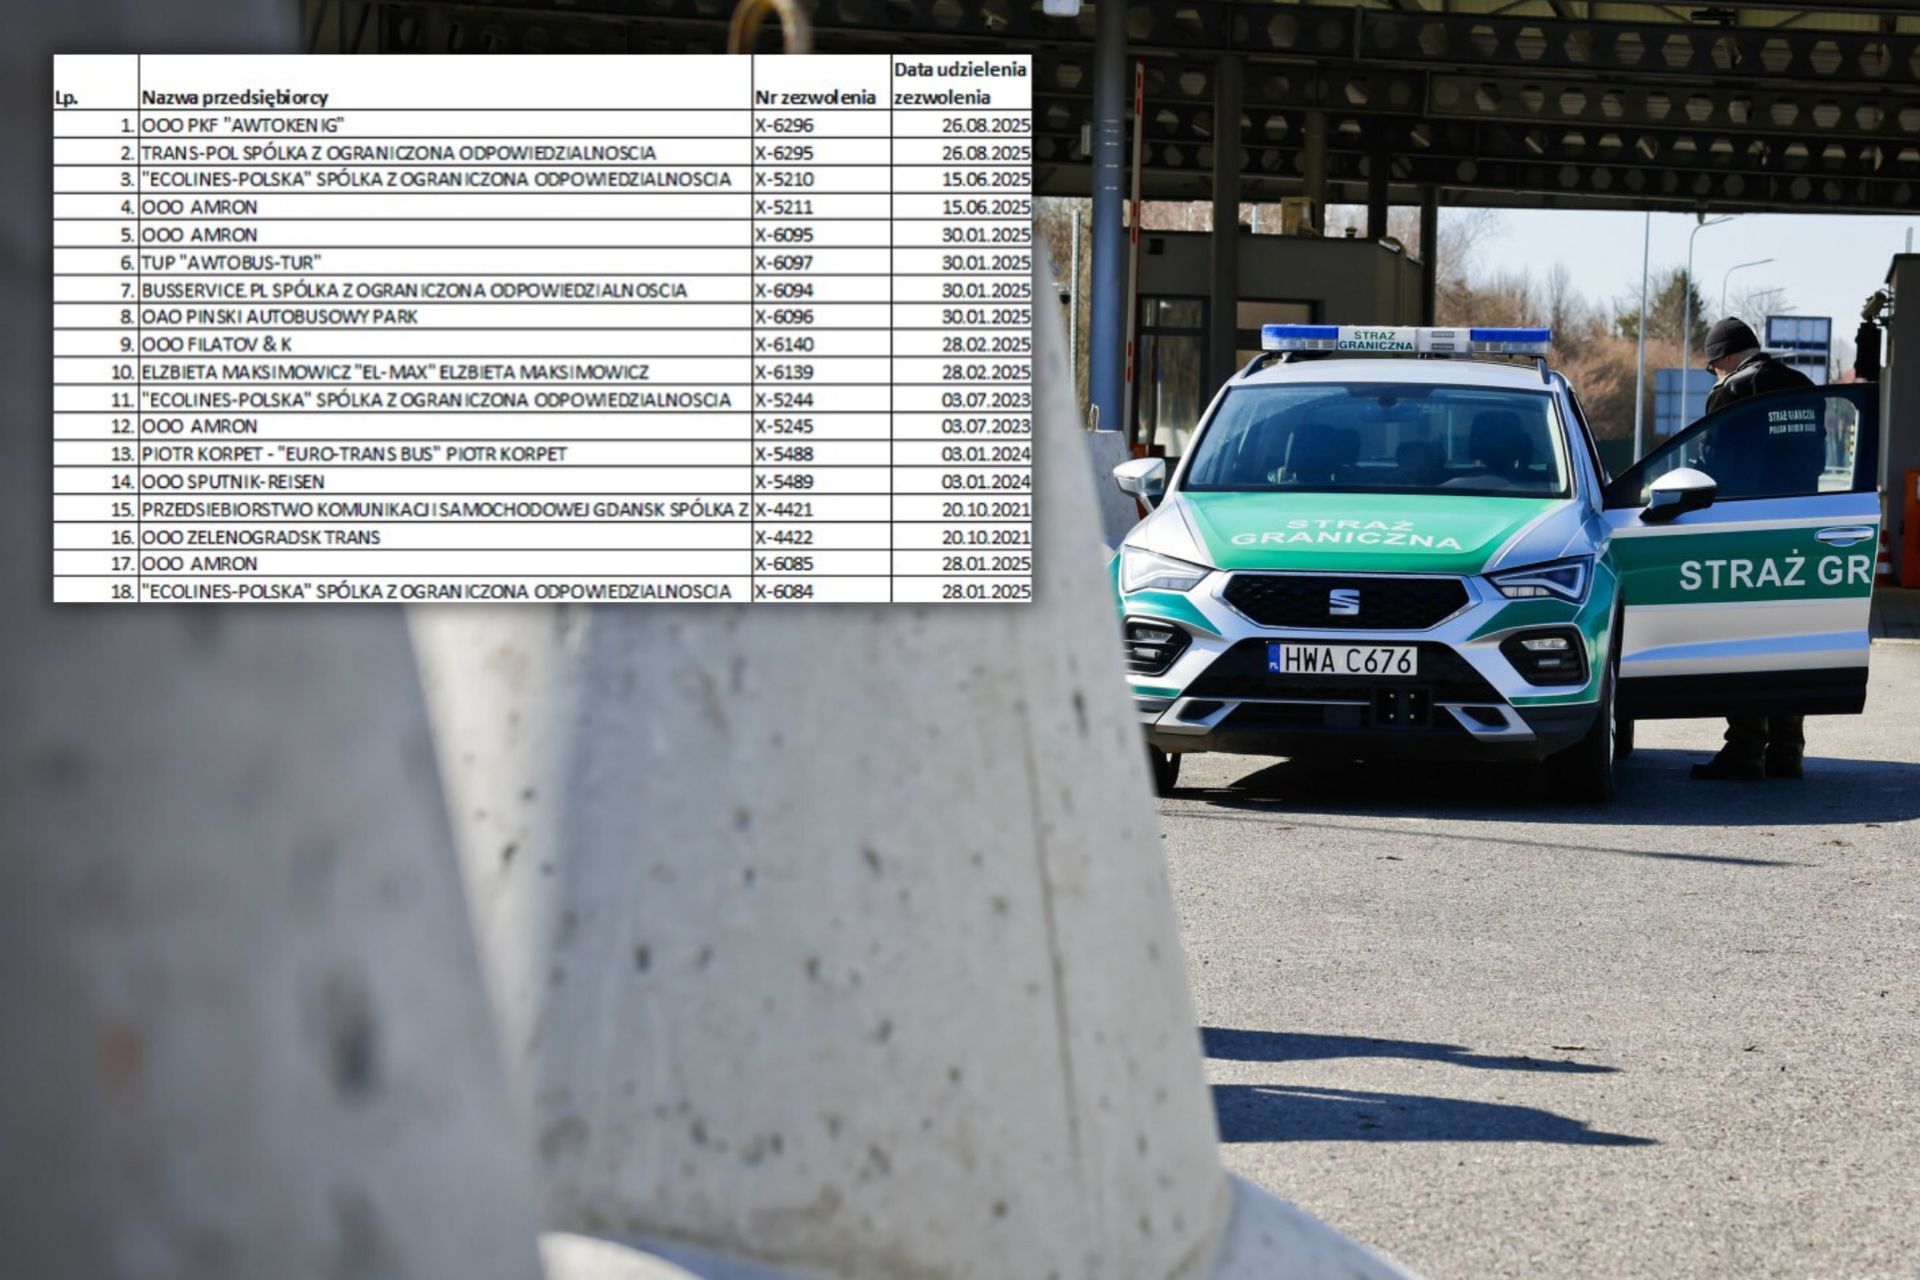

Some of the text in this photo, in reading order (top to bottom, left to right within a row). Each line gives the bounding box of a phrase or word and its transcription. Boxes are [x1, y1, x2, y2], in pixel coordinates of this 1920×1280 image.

[1339, 341, 1413, 350] GRANICZNA
[1287, 519, 1414, 531] STRAŻ
[1231, 532, 1462, 550] GRANICZNA
[1680, 549, 1871, 590] STRAŻ GR
[1286, 647, 1411, 673] HWA C676
